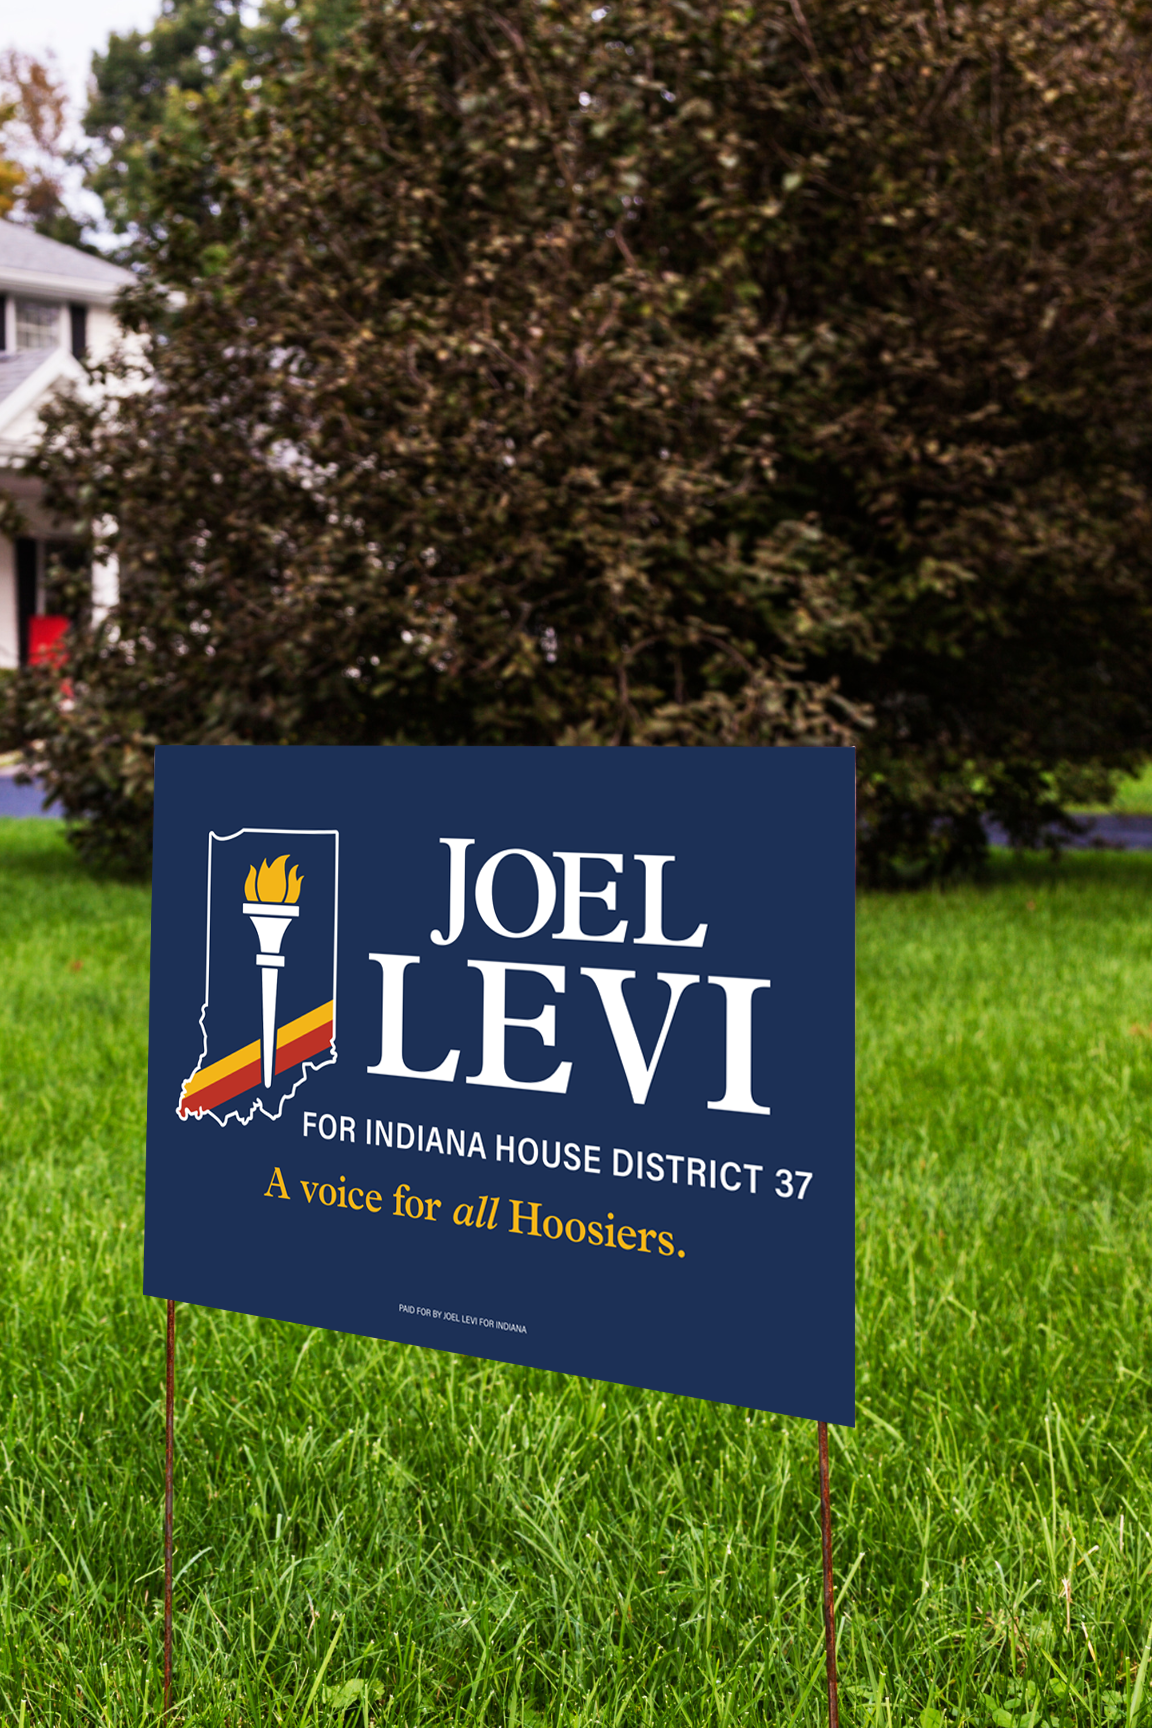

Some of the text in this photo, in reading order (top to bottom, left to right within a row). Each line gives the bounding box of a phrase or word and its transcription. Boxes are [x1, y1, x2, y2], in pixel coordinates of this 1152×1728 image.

[430, 838, 708, 947] JOEL
[367, 953, 771, 1115] LEVI
[303, 1111, 813, 1199] FOR INDIANA HOUSE DISTRICT 37
[264, 1167, 685, 1258] A voice for all Hoosiers.
[399, 1304, 527, 1334] PAID FOR BY JOEL LEVI FOR INDIANA
